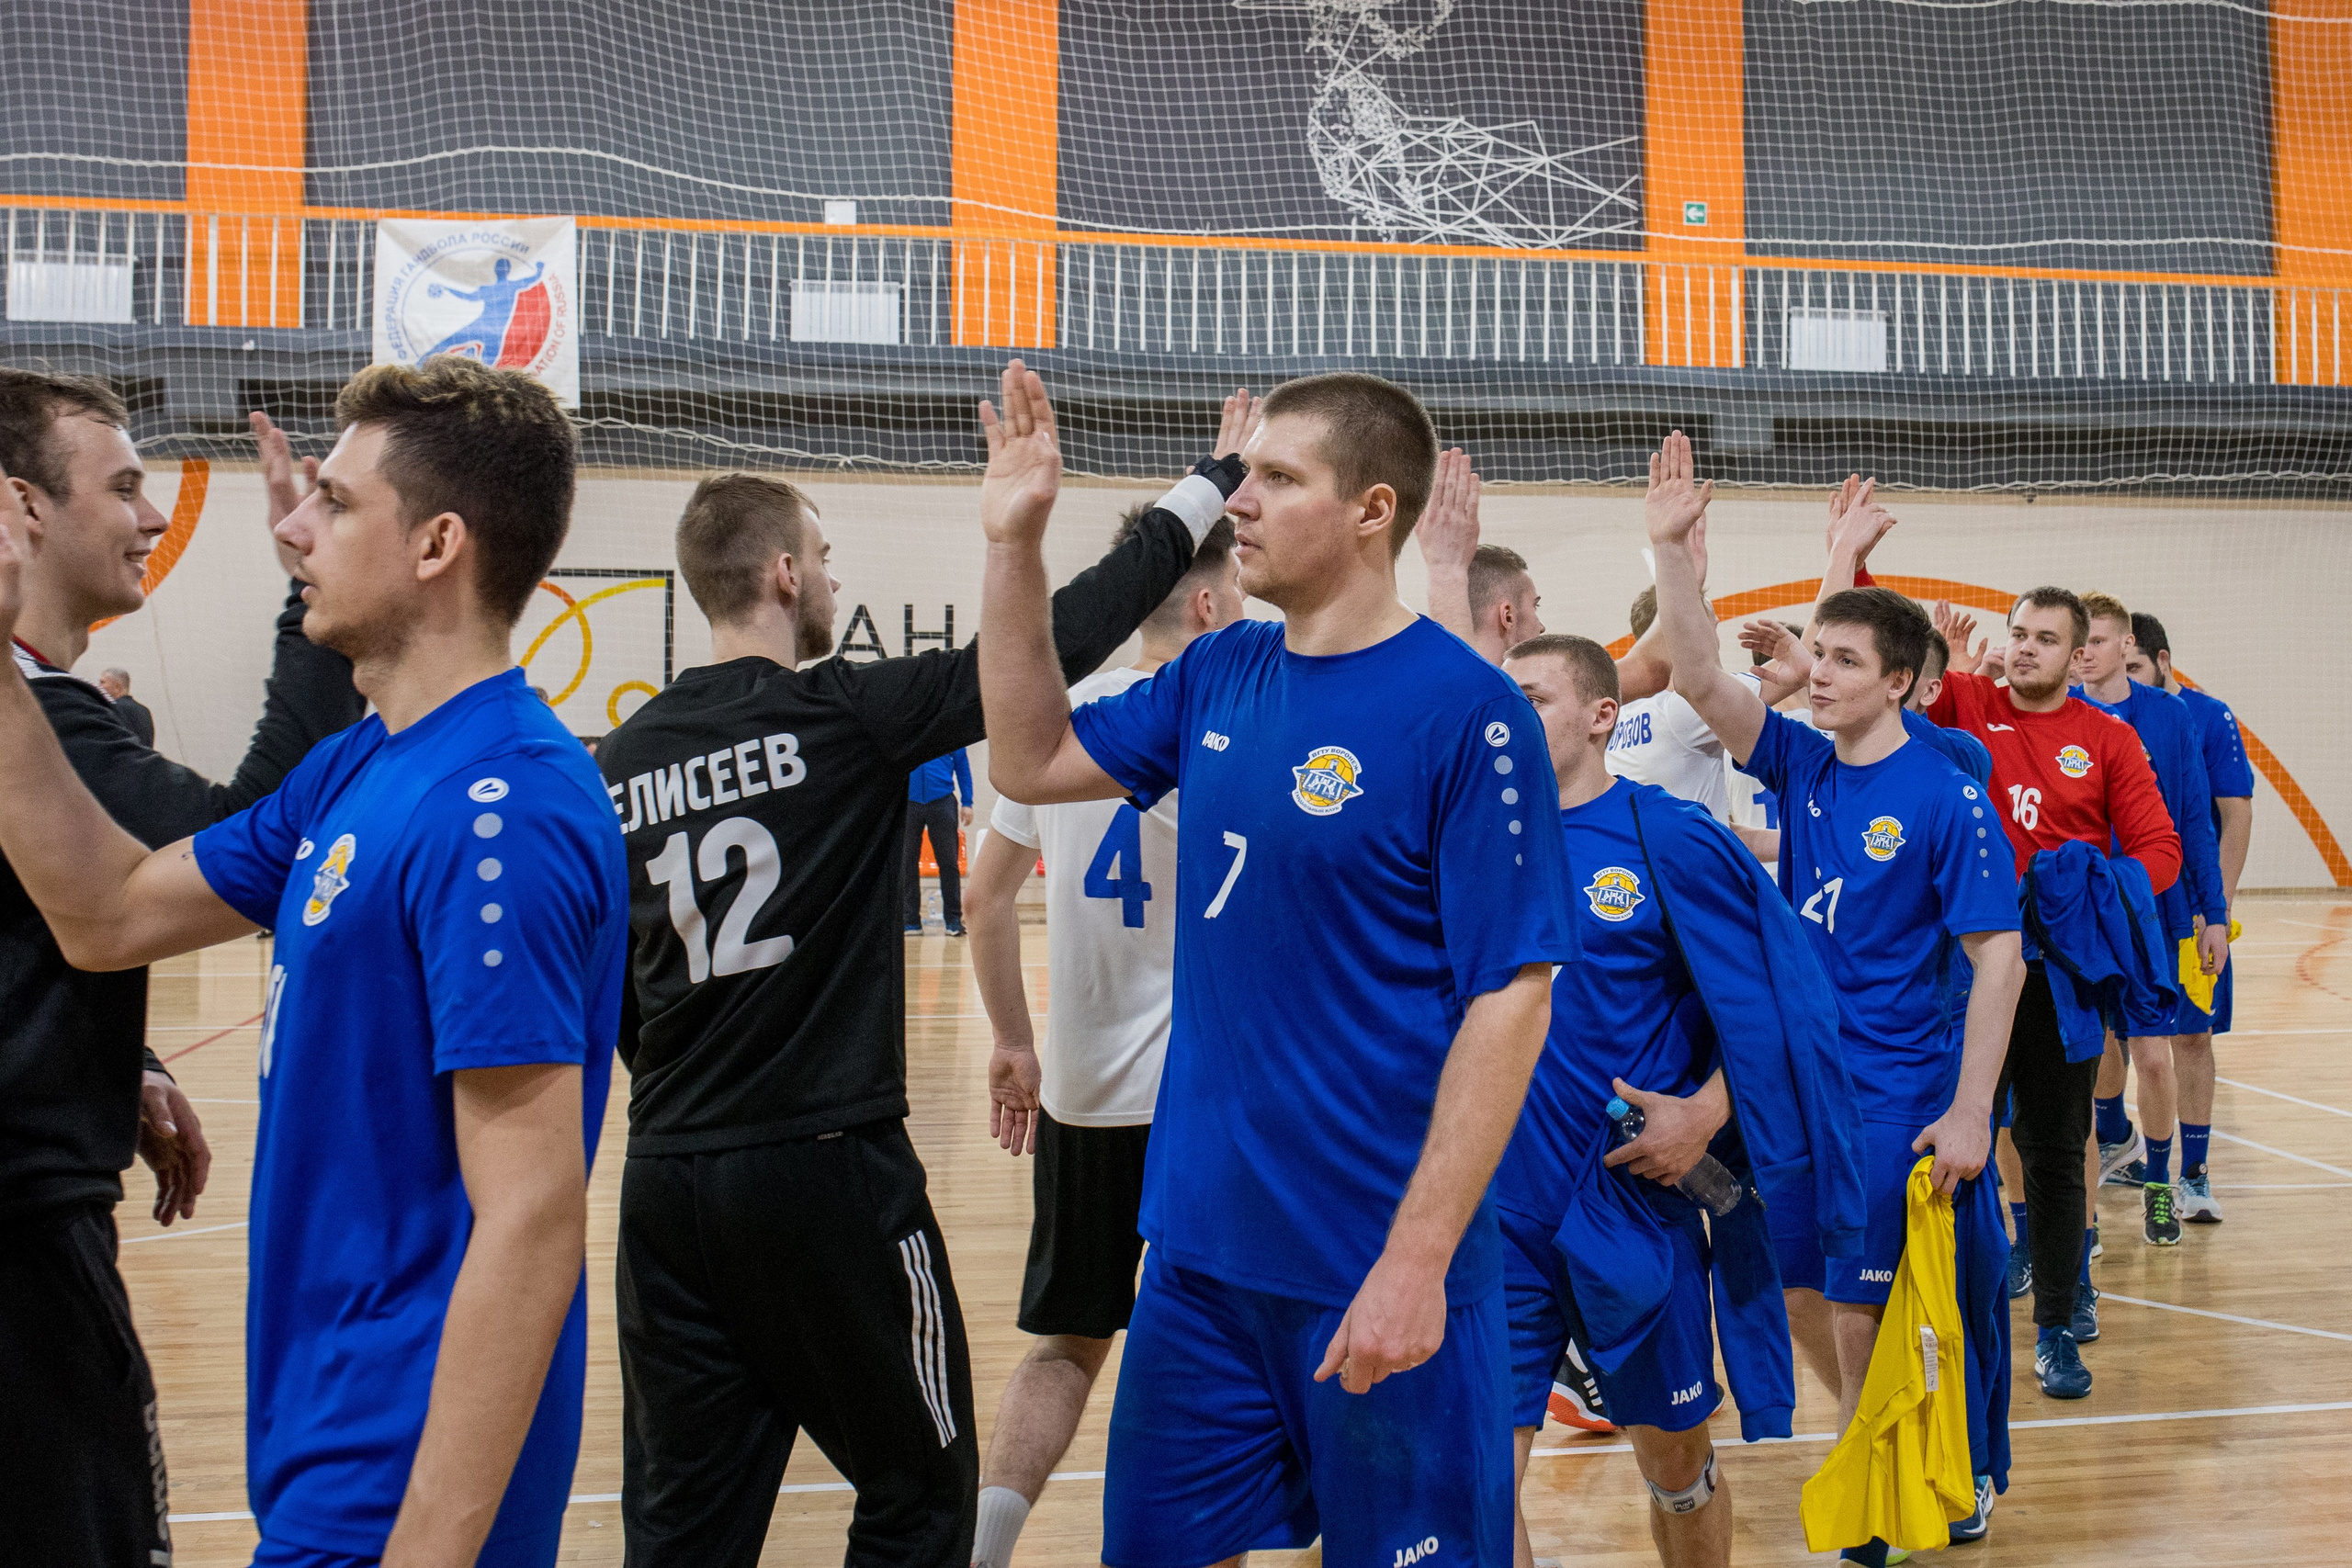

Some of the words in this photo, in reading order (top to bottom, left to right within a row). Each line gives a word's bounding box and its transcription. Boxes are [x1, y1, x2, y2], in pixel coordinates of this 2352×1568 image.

[385, 278, 407, 360] ФЕДЕРАЦИЯ
[400, 233, 469, 278] ГАНДБОЛА
[471, 231, 530, 254] РОССИИ
[548, 272, 569, 320] RUSSIA
[553, 322, 566, 339] OF
[530, 343, 560, 378] ATION
[1608, 712, 1653, 751] ОРОЗОВ
[1311, 748, 1330, 759] ВГТУ
[1330, 748, 1360, 773] ВОРОНЕЖ
[607, 732, 808, 836] ЕЛИСЕЕВ
[2007, 784, 2042, 831] 16
[1084, 803, 1152, 929] 4
[1204, 830, 1248, 919] 7
[1610, 868, 1638, 884] ВОРОНЕЖ
[645, 817, 795, 985] 12
[1859, 1269, 1894, 1282] JAKO
[1671, 1381, 1702, 1405] JAKO
[1393, 1535, 1439, 1568] JAKO
